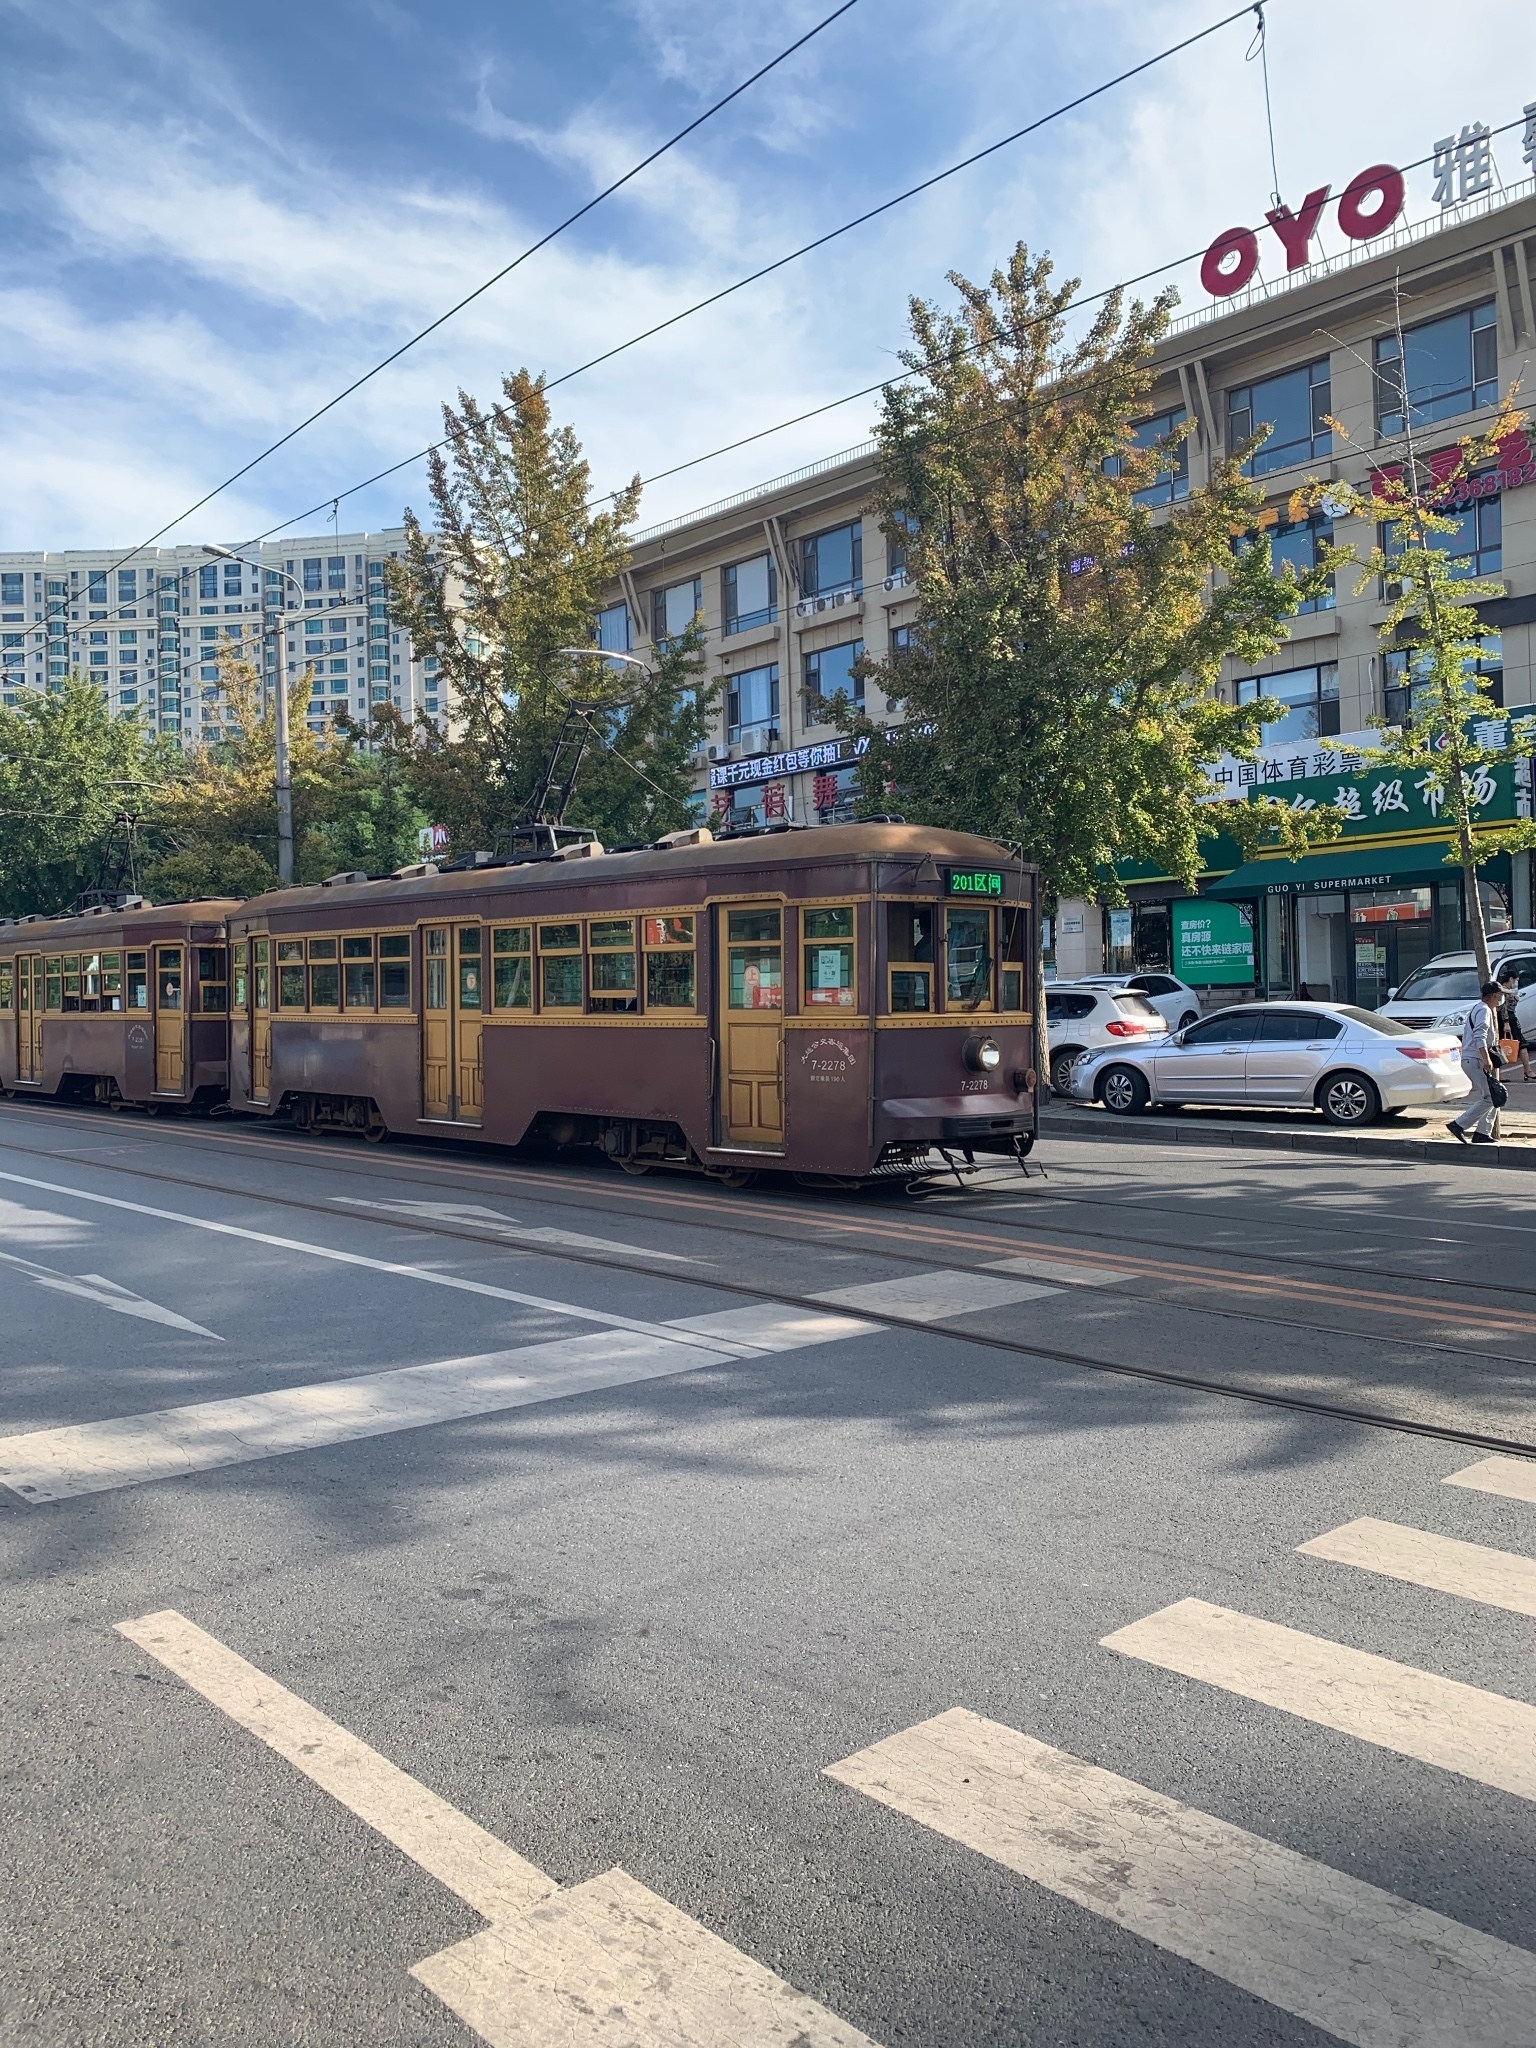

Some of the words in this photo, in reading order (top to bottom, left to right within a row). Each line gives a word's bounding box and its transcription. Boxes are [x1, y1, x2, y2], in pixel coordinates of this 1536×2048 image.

[1200, 163, 1405, 297] OYO
[1473, 714, 1536, 751] 董
[1214, 751, 1363, 788] 中国体育彩票
[952, 873, 1002, 895] 201区间
[1267, 884, 1289, 894] GUO
[1295, 883, 1305, 892] YI
[1313, 875, 1392, 890] SUPERMARKET
[1180, 919, 1212, 931] 查房价?
[1181, 931, 1212, 944] 真房源
[1181, 942, 1253, 957] 还不快来链家网
[811, 1060, 846, 1071] 7-2278
[961, 1080, 988, 1091] 7-2278
